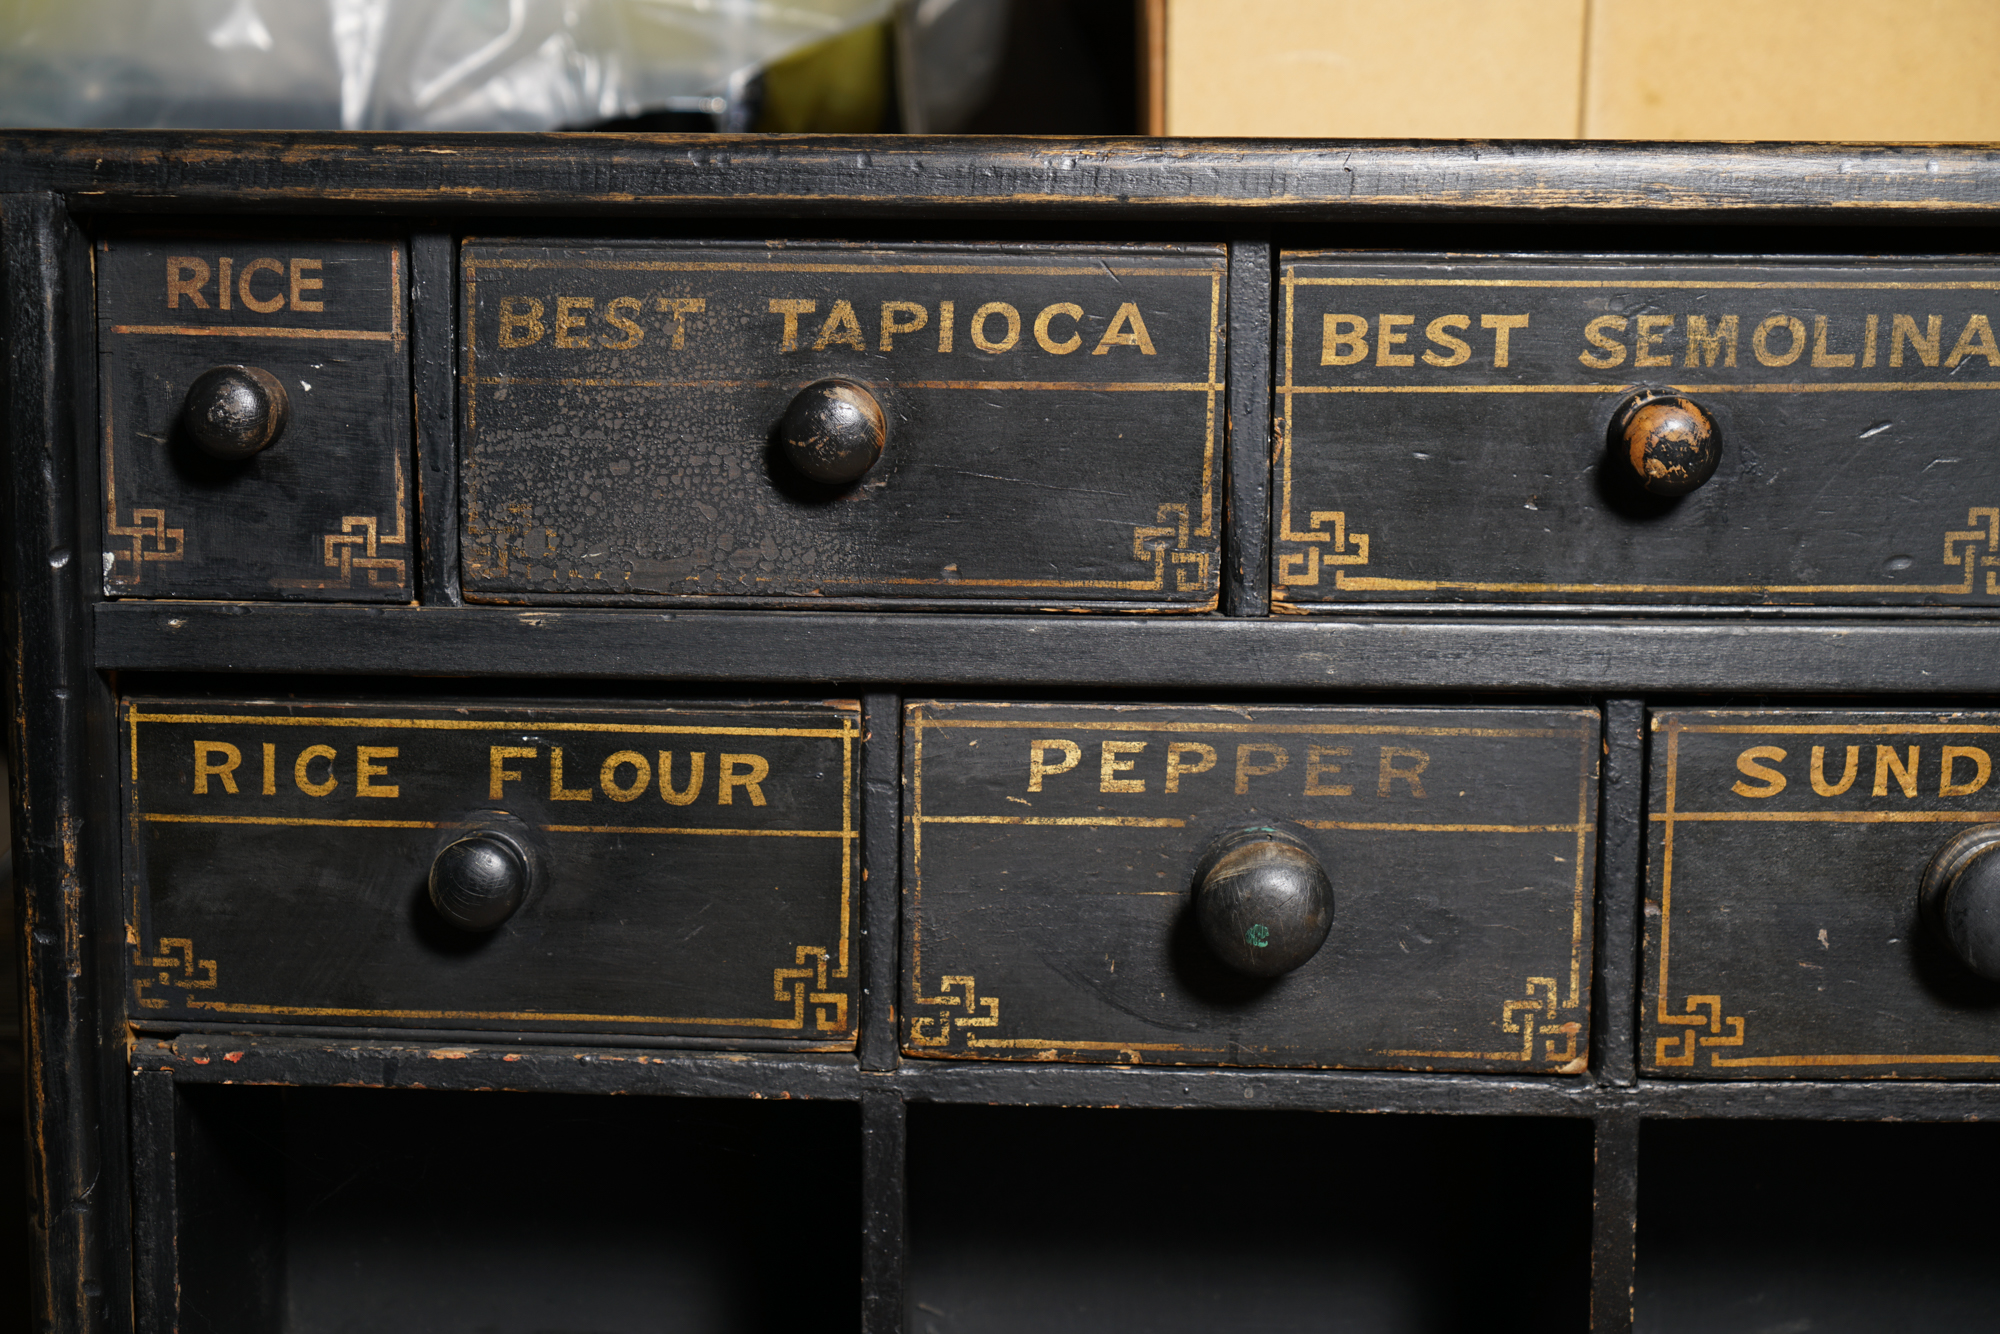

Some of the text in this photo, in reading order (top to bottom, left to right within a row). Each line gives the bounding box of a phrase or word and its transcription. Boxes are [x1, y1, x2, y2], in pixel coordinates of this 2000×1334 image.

[166, 256, 324, 314] RICE
[497, 295, 1157, 355] BEST TAPIOCA
[1320, 311, 2000, 370] BEST SEMOLINA
[192, 740, 769, 807] RICE FLOUR
[1027, 739, 1430, 798] PEPPER
